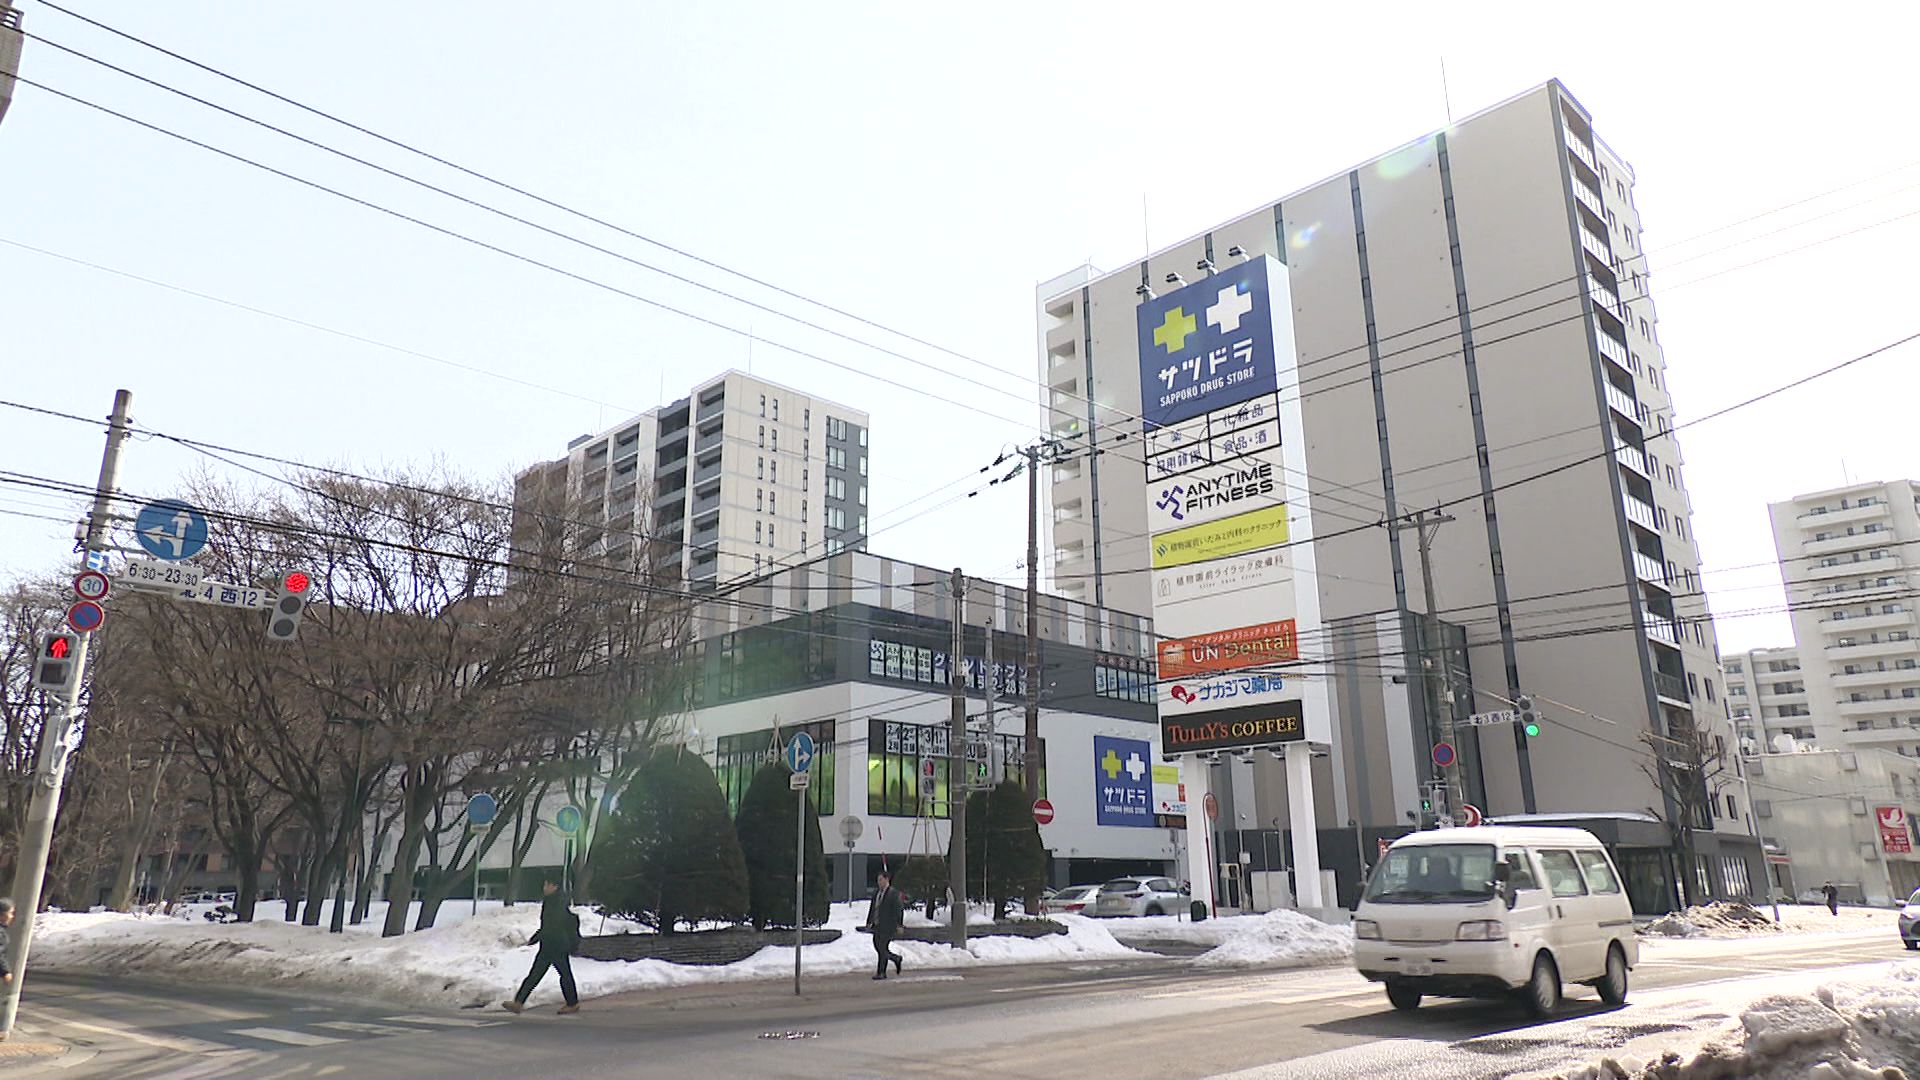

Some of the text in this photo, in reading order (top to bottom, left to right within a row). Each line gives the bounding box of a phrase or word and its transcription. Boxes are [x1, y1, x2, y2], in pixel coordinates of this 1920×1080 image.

[1158, 337, 1253, 390] サツドラ
[1160, 366, 1255, 407] SAPPORO DRUG STORE
[1186, 463, 1272, 498] ANYTIME
[1186, 479, 1274, 513] FITNESS
[82, 578, 102, 593] 30
[129, 562, 198, 587] 6:30-23:30
[1192, 644, 1219, 663] UN
[1225, 631, 1290, 658] Dental
[1199, 676, 1283, 700] ナカジマ薬局
[1168, 716, 1298, 744] TULLY'S COFFEE
[1104, 786, 1146, 804] サツドラ
